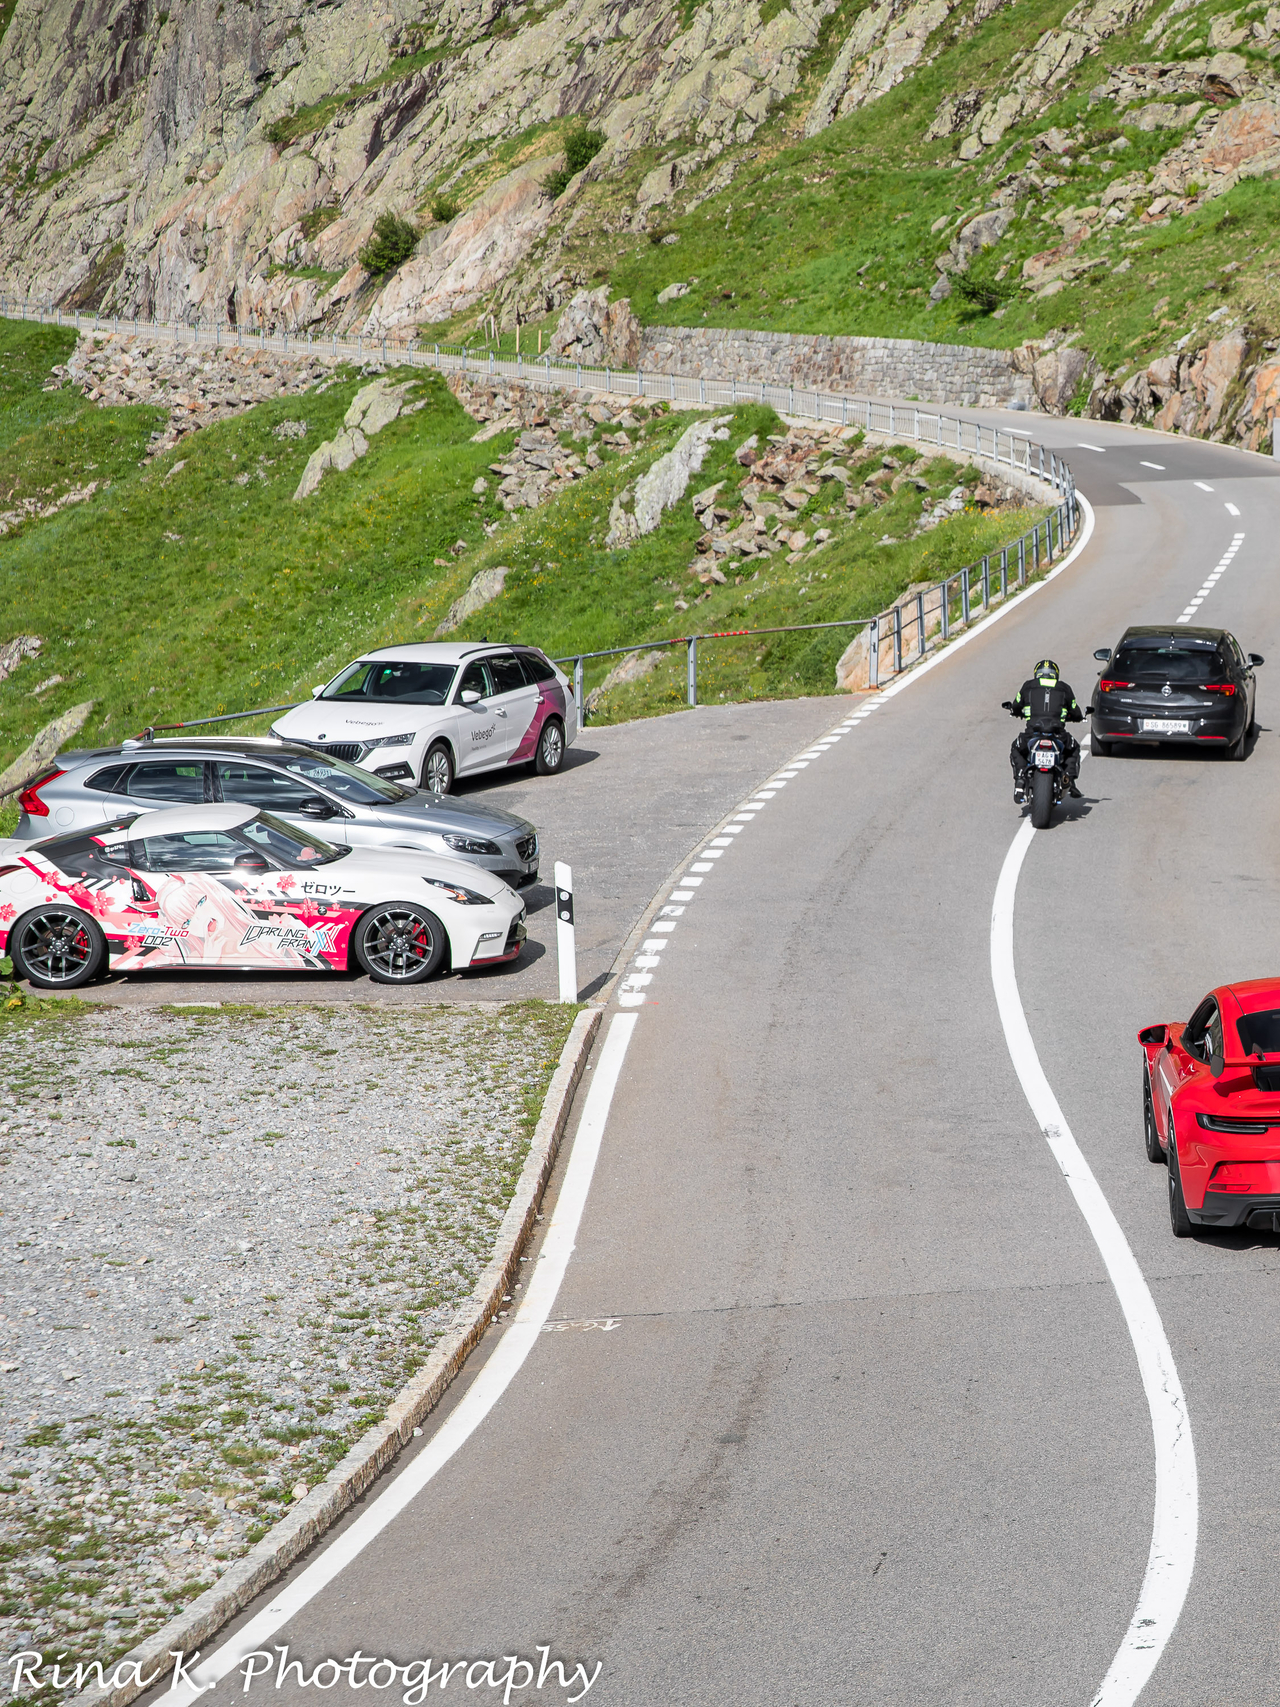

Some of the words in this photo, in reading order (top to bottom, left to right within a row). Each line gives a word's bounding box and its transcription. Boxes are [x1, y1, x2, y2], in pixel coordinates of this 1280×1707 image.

[1150, 721, 1159, 729] SG
[471, 729, 493, 741] Vebego
[301, 881, 356, 896] ゼロツー
[143, 935, 173, 947] 002
